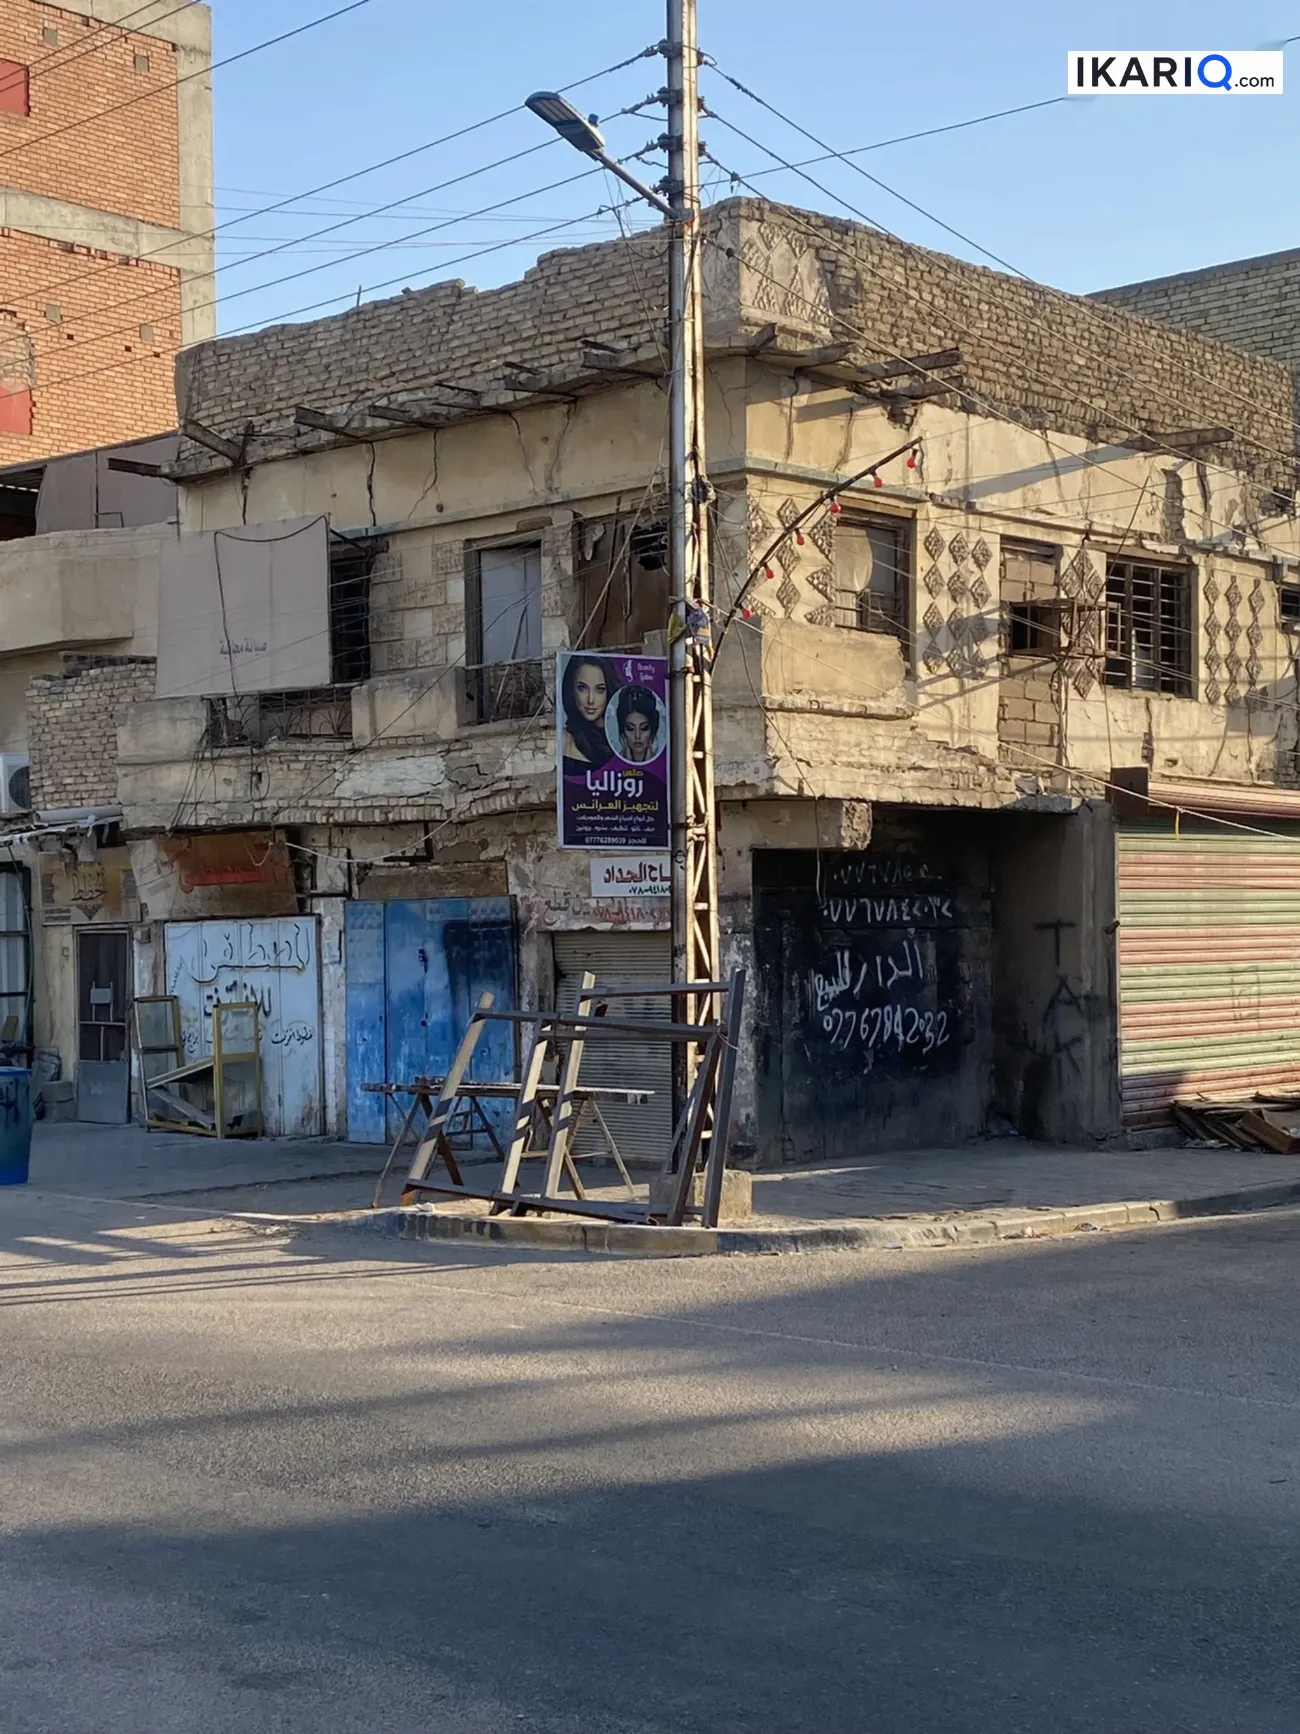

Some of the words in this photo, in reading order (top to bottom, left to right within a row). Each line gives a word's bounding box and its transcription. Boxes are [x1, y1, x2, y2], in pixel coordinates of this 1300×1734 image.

[586, 770, 644, 798] روزاليا
[622, 800, 659, 813] لتجهيز
[603, 861, 648, 885] الحداد
